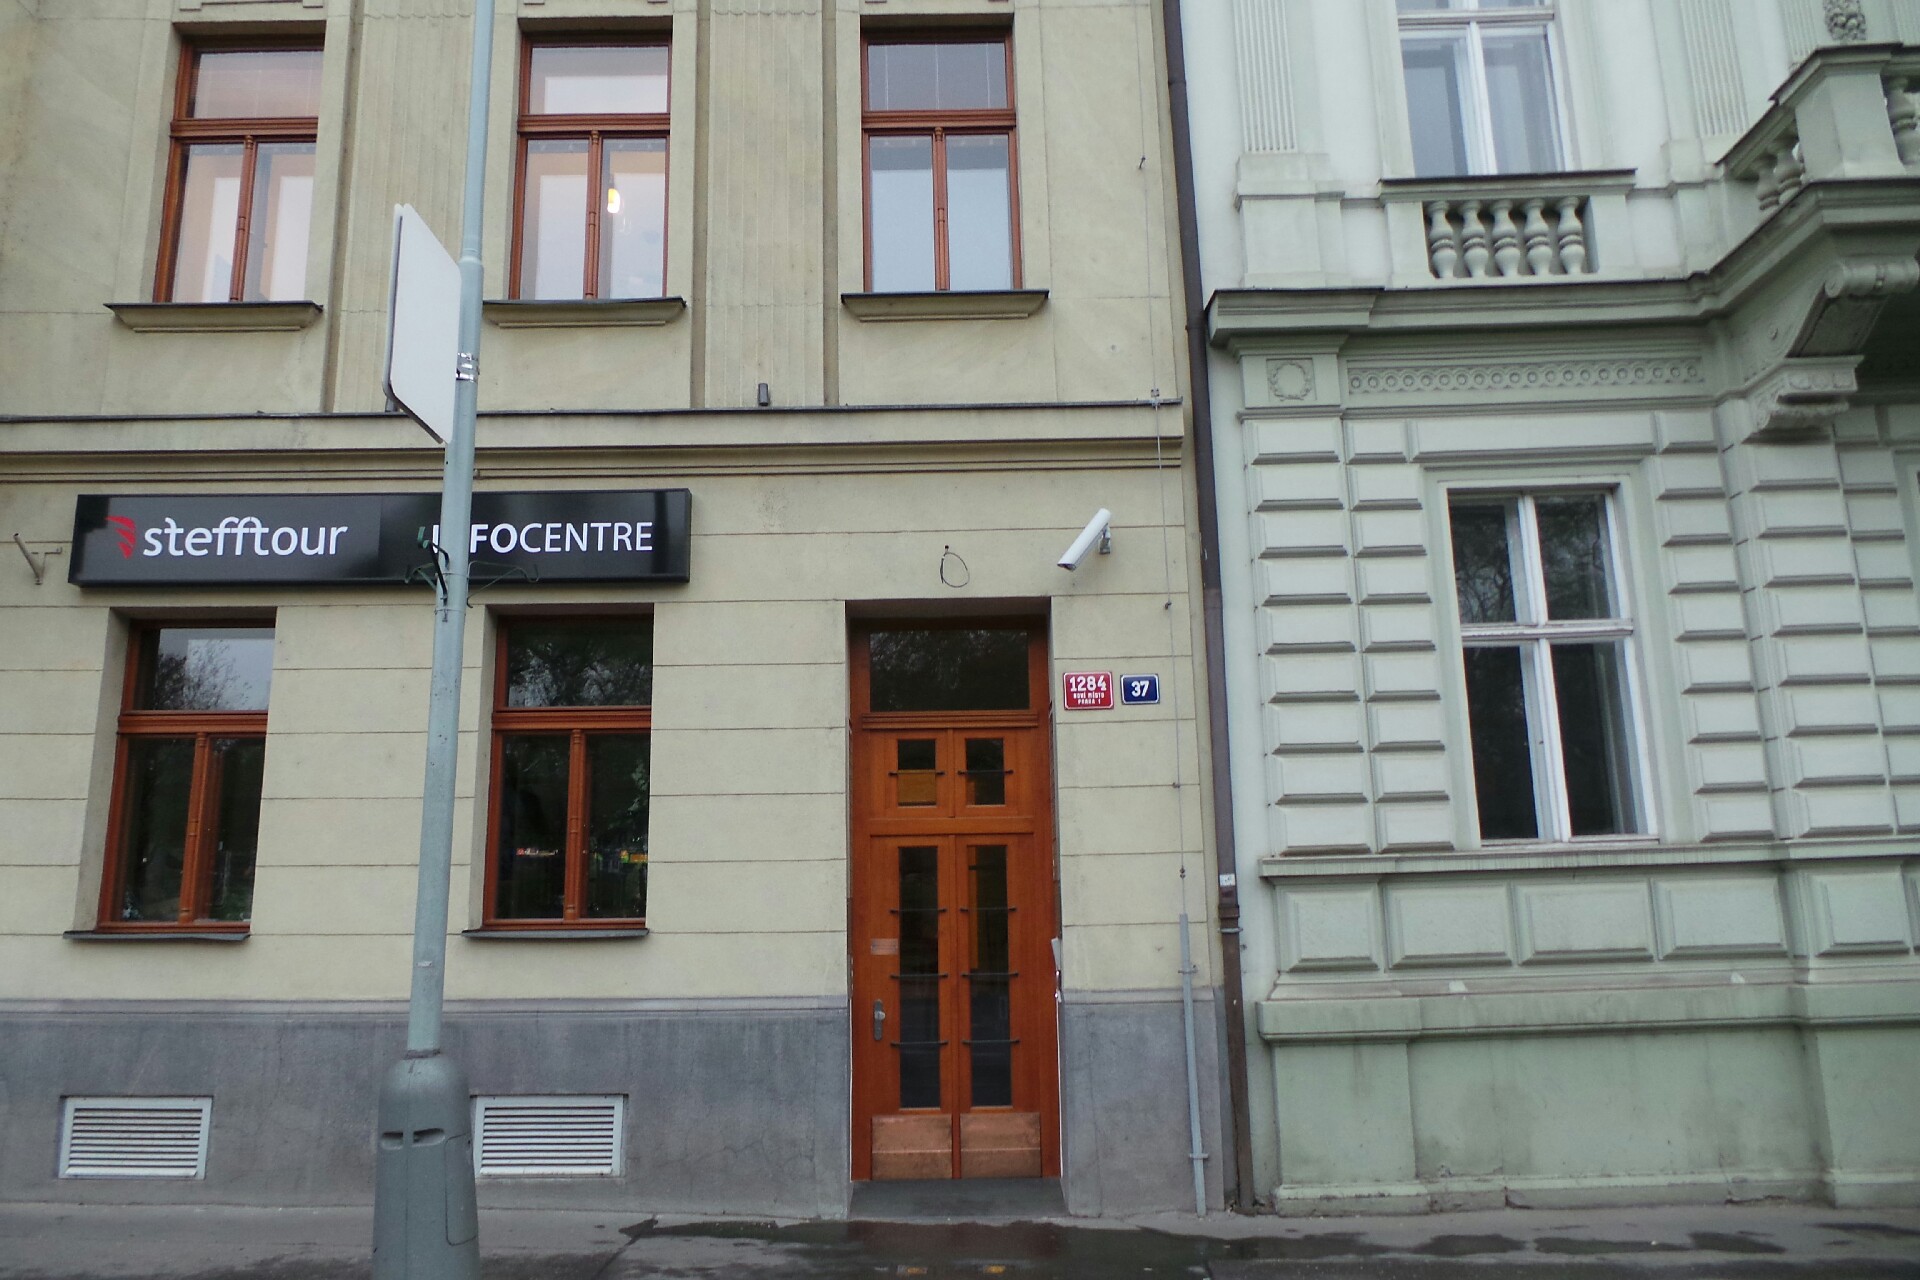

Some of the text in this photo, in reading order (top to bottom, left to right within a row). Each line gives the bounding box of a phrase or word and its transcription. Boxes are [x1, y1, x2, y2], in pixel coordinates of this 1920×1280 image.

[143, 516, 348, 556] stefftour
[432, 521, 653, 554] IFOCENTRE
[1069, 675, 1106, 691] 1284
[1131, 681, 1149, 697] 37
